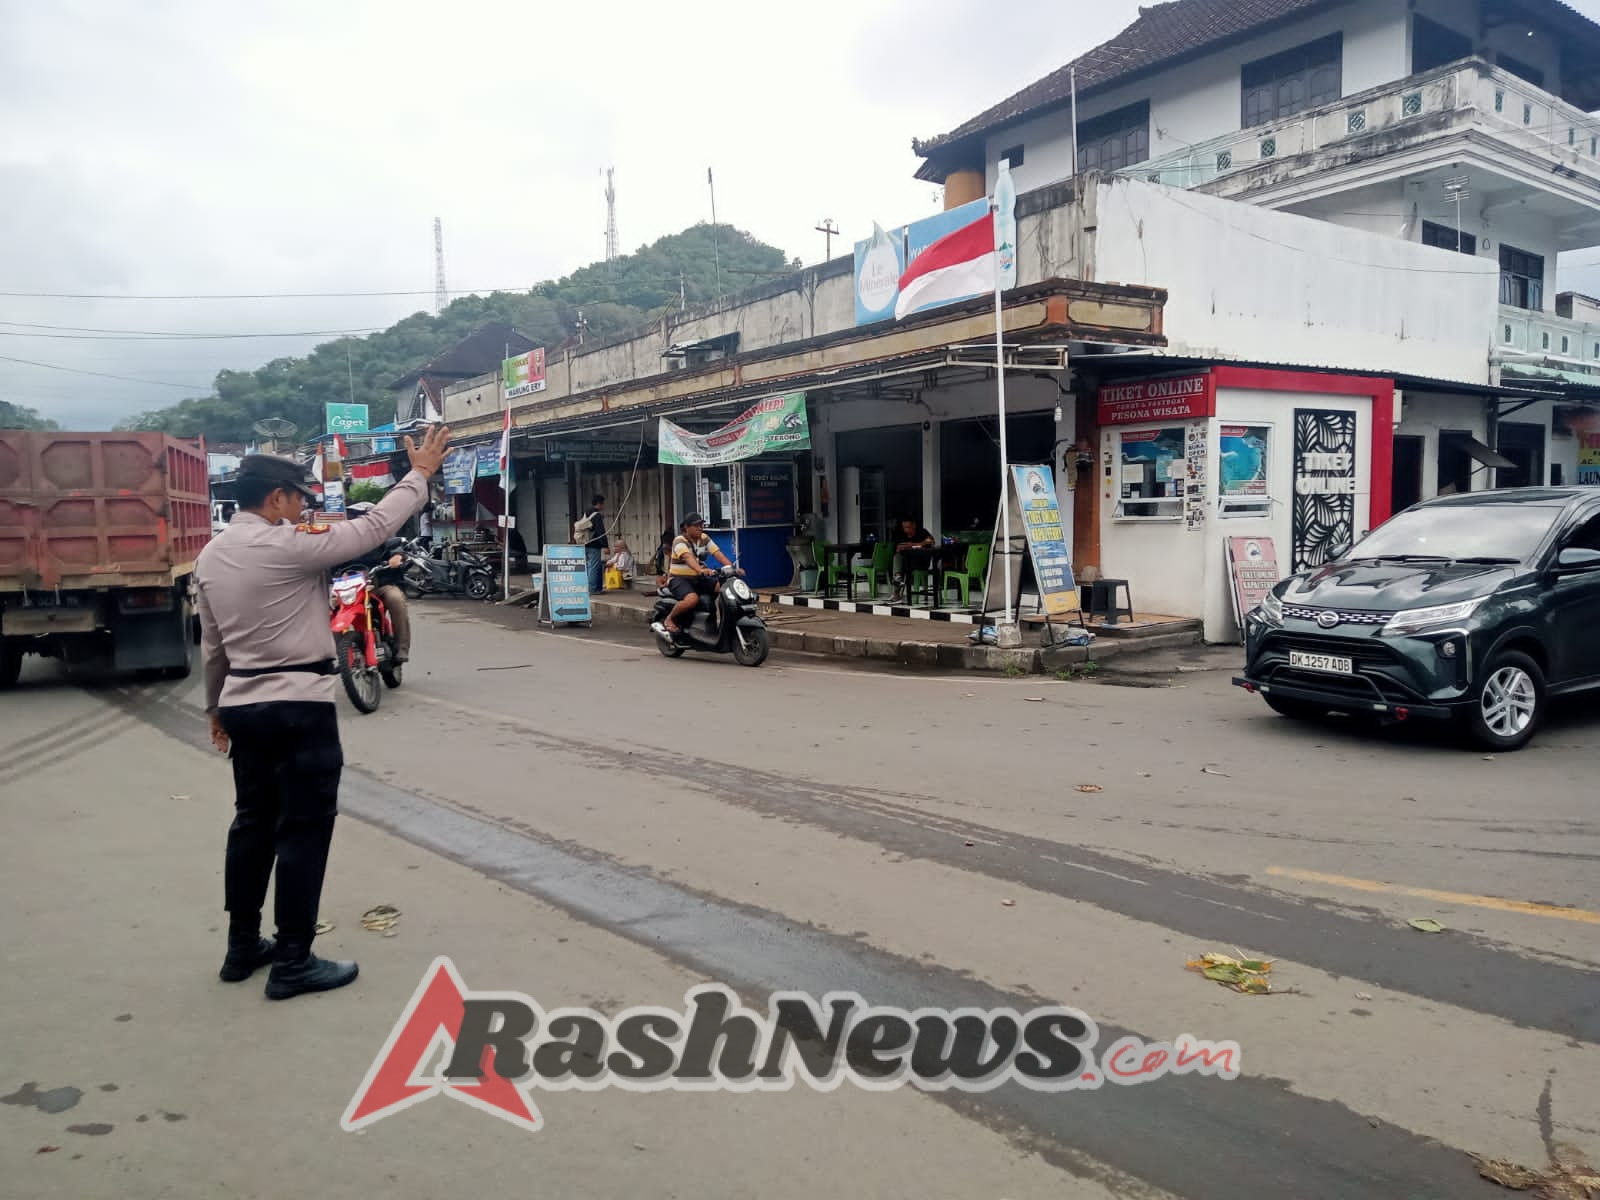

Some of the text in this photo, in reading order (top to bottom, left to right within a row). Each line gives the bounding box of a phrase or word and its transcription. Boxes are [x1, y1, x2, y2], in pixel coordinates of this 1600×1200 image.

[508, 383, 530, 396] WARUNG
[1103, 379, 1203, 402] TIKET ONLINE
[1111, 405, 1191, 420] PESONA WISATA
[1291, 653, 1350, 672] DK 1257 ADB
